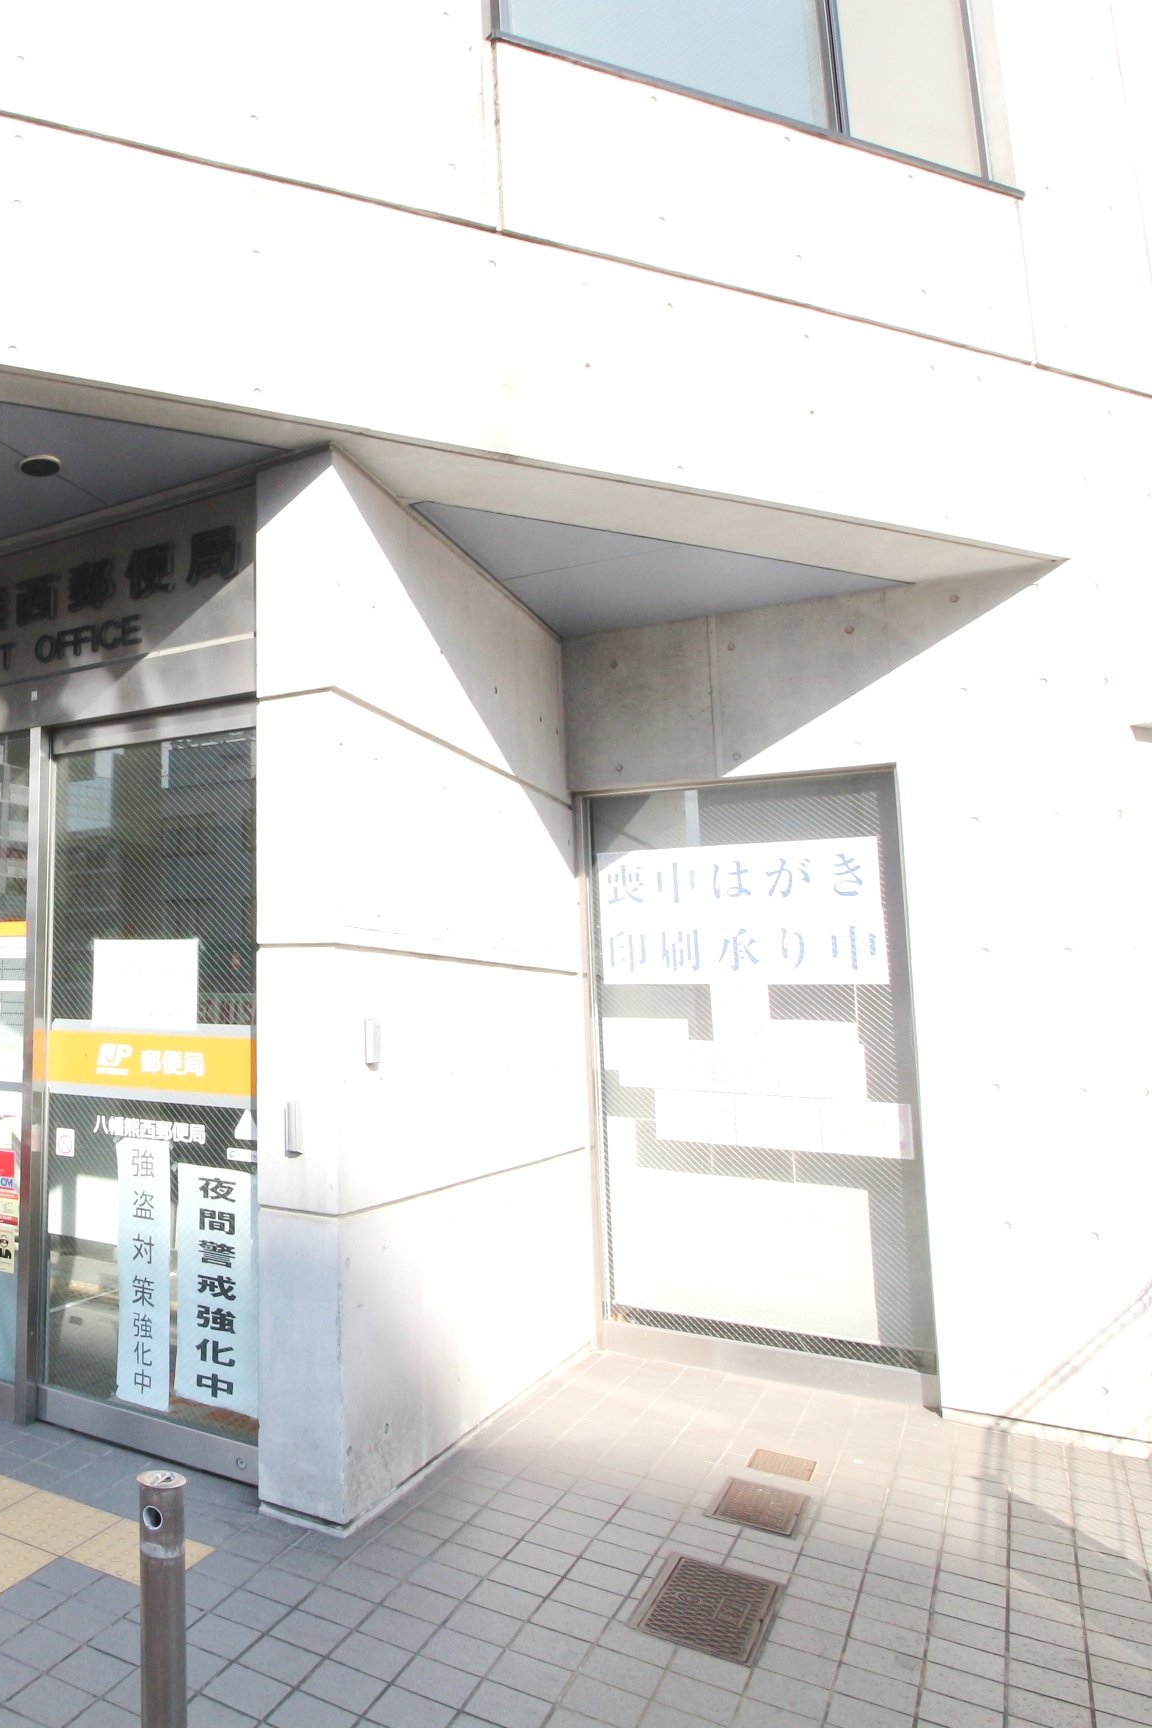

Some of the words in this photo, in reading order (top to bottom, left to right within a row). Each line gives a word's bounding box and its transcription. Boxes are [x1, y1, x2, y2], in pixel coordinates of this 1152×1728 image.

[34, 615, 143, 664] OFFICE
[607, 853, 863, 905] 喪中はがき
[607, 925, 877, 972] 印刷承り中
[140, 1050, 204, 1077] 郵便局
[93, 1114, 206, 1145] 八幡熊西郵便局
[131, 1148, 155, 1396] 強盗対策強化中
[195, 1176, 237, 1398] 夜間警戒強化中
